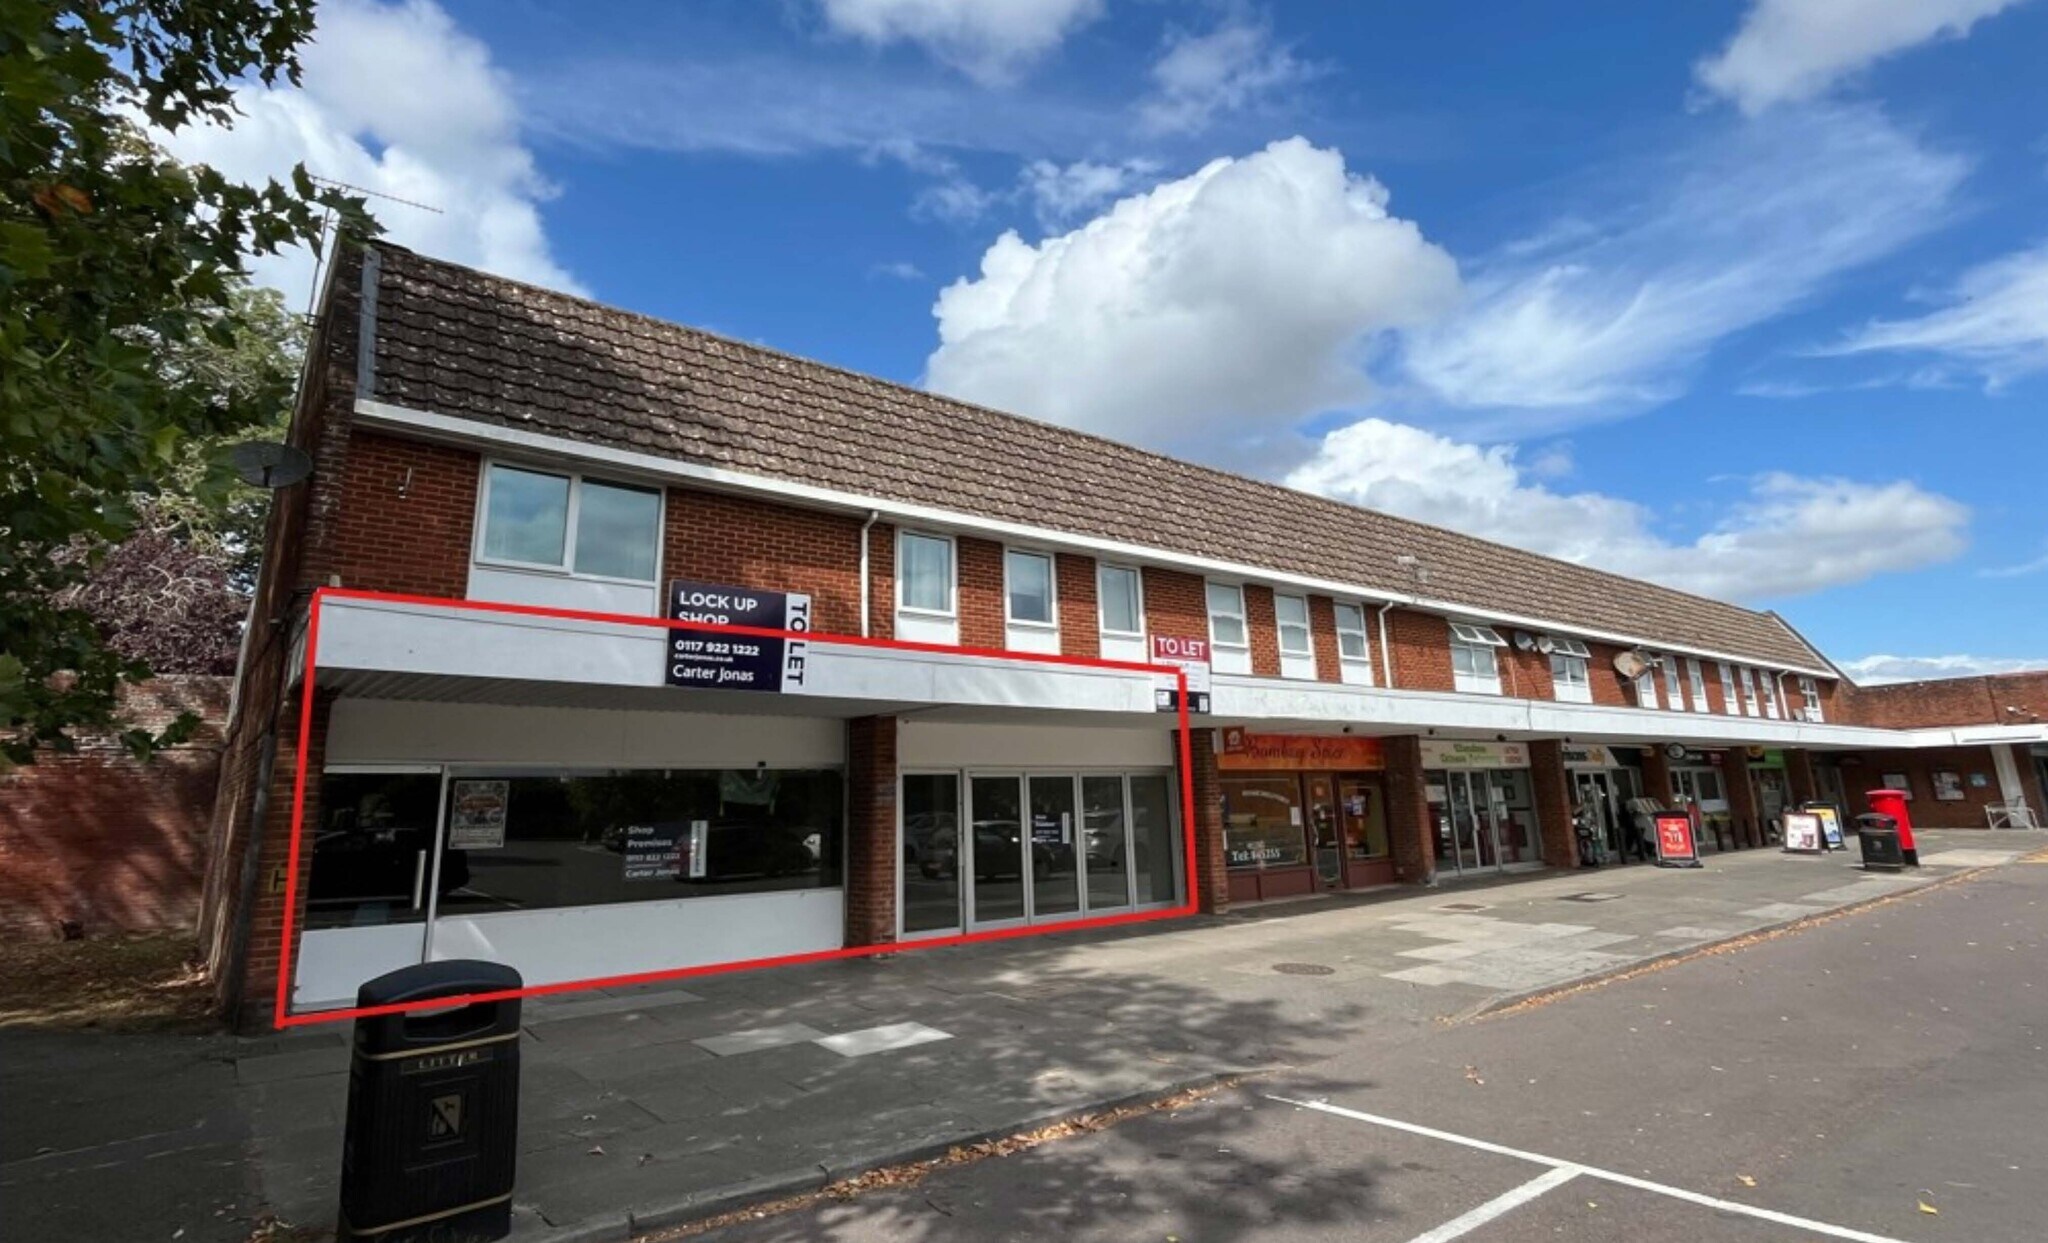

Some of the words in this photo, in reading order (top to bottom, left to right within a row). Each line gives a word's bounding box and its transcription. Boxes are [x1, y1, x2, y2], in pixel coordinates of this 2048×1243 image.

[679, 591, 729, 609] LOCK
[734, 595, 758, 612] UP
[678, 611, 730, 627] SHOP
[790, 603, 807, 633] TO
[675, 639, 703, 652] 0117
[705, 642, 730, 655] 922
[732, 644, 760, 657] 1222
[1157, 637, 1178, 655] TO
[1183, 640, 1205, 657] LET
[672, 664, 717, 680] Carter
[717, 666, 755, 683] Jonas
[788, 642, 805, 686] LET
